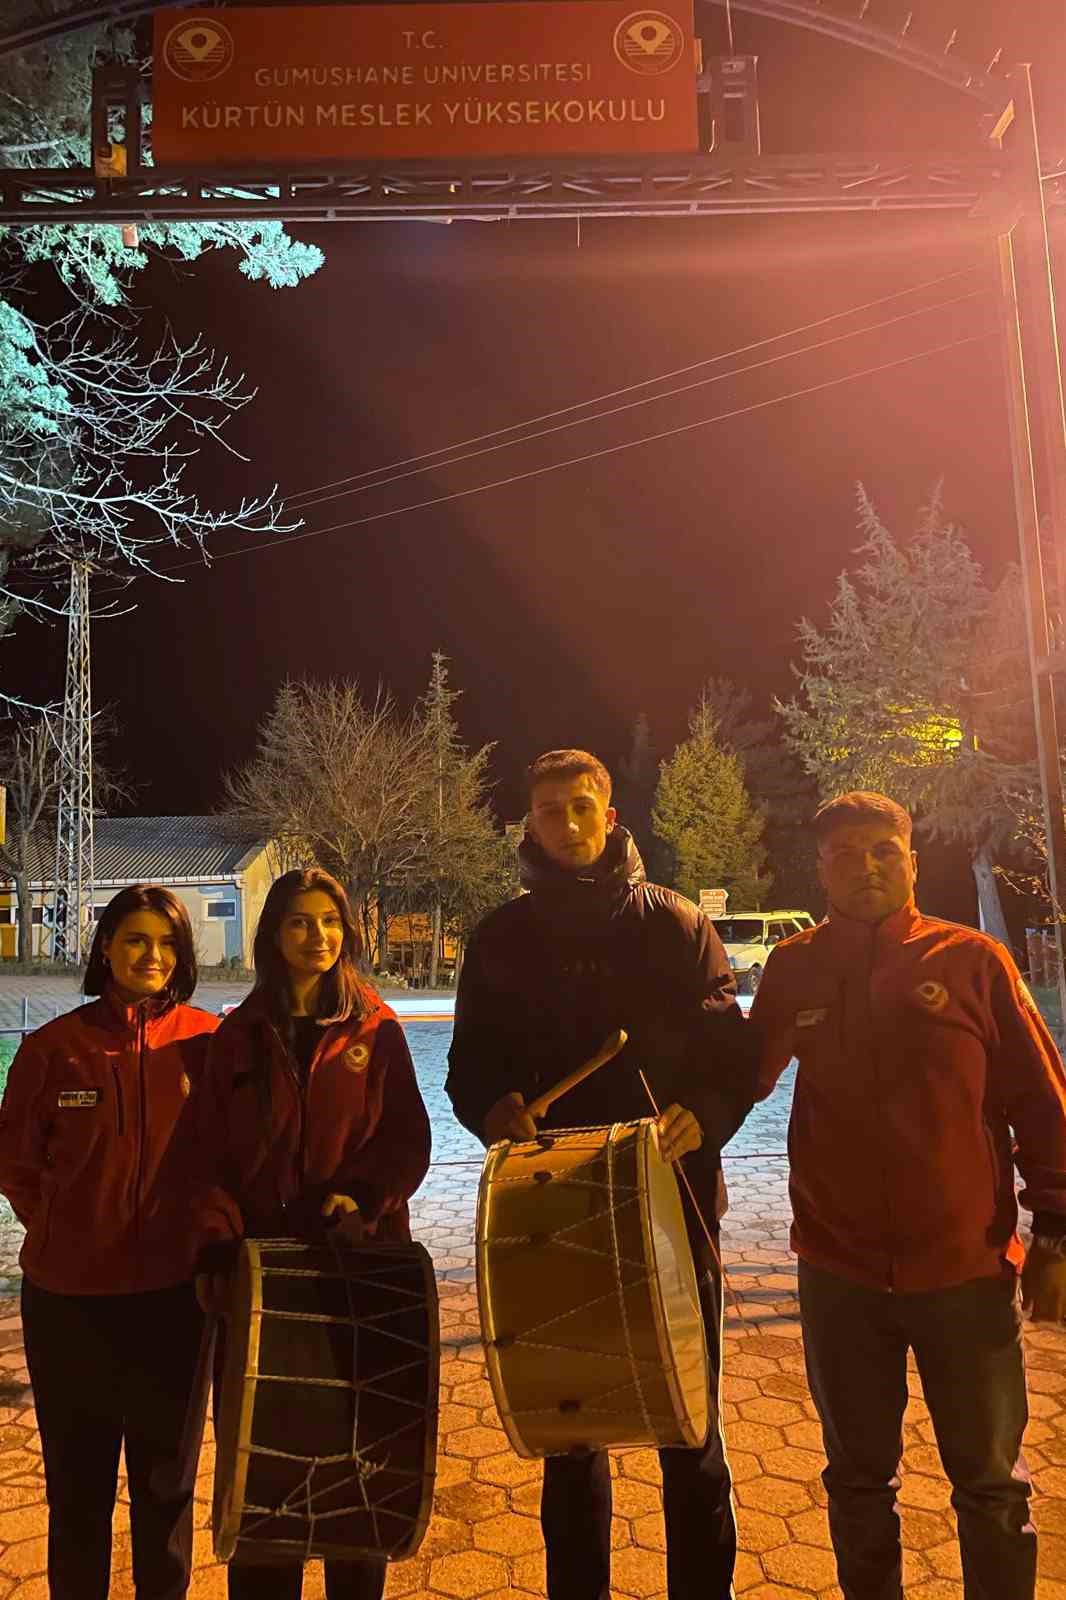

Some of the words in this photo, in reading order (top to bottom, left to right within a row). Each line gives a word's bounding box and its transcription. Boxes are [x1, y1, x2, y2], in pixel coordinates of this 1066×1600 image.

[401, 31, 444, 49] T.C.
[182, 101, 304, 129] KÜRTÜN
[316, 103, 433, 127] MESLEK
[444, 98, 665, 125] YÜKSEKOKULU
